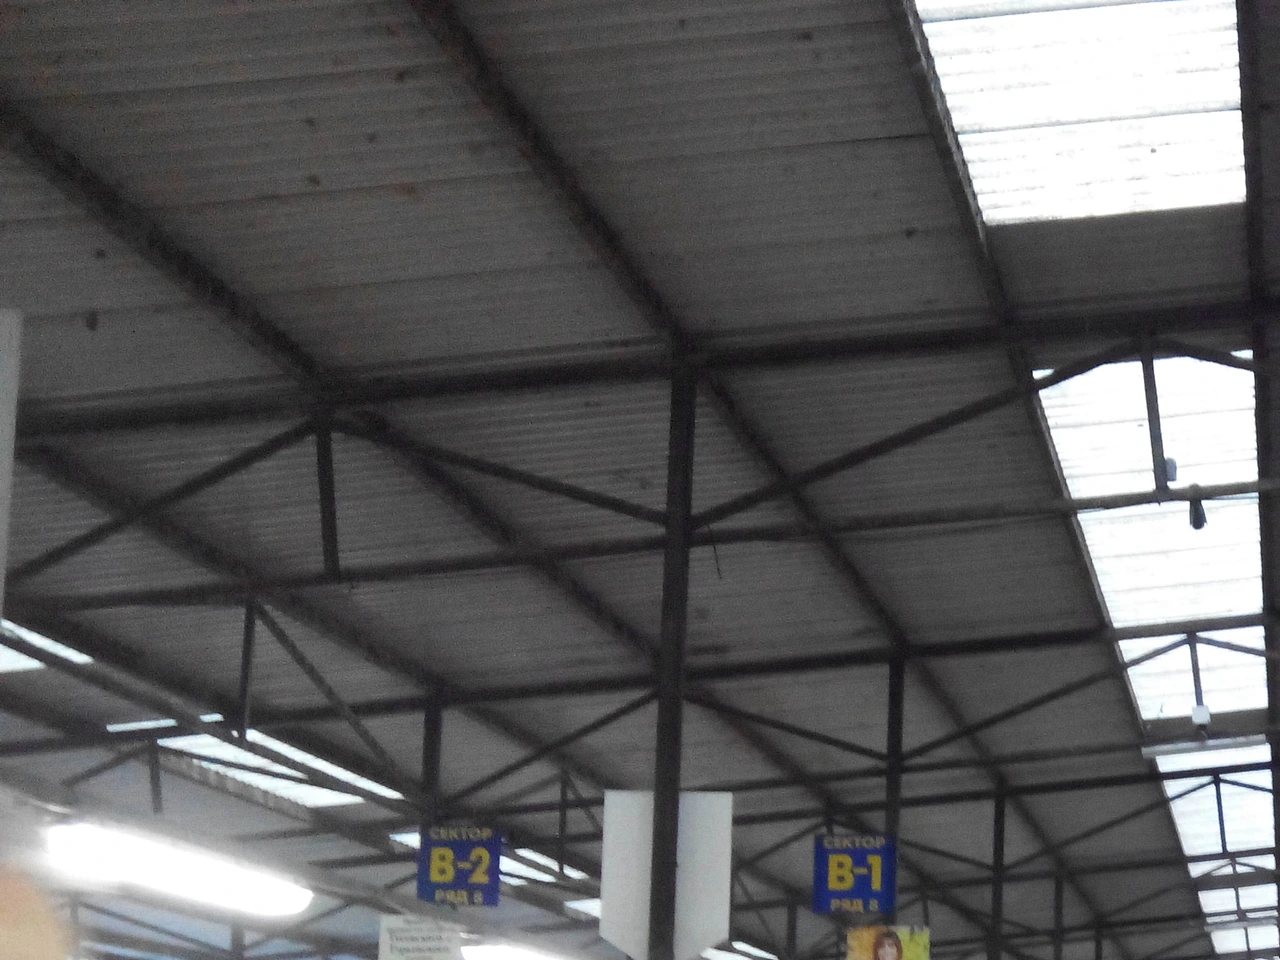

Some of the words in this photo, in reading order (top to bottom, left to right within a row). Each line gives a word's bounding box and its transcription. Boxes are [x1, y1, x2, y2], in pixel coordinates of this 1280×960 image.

[429, 826, 493, 840] СЕКТОР
[823, 836, 886, 849] СЕКТОР
[430, 846, 490, 884] В-2
[828, 854, 882, 891] В-1
[830, 898, 864, 914] РЯД
